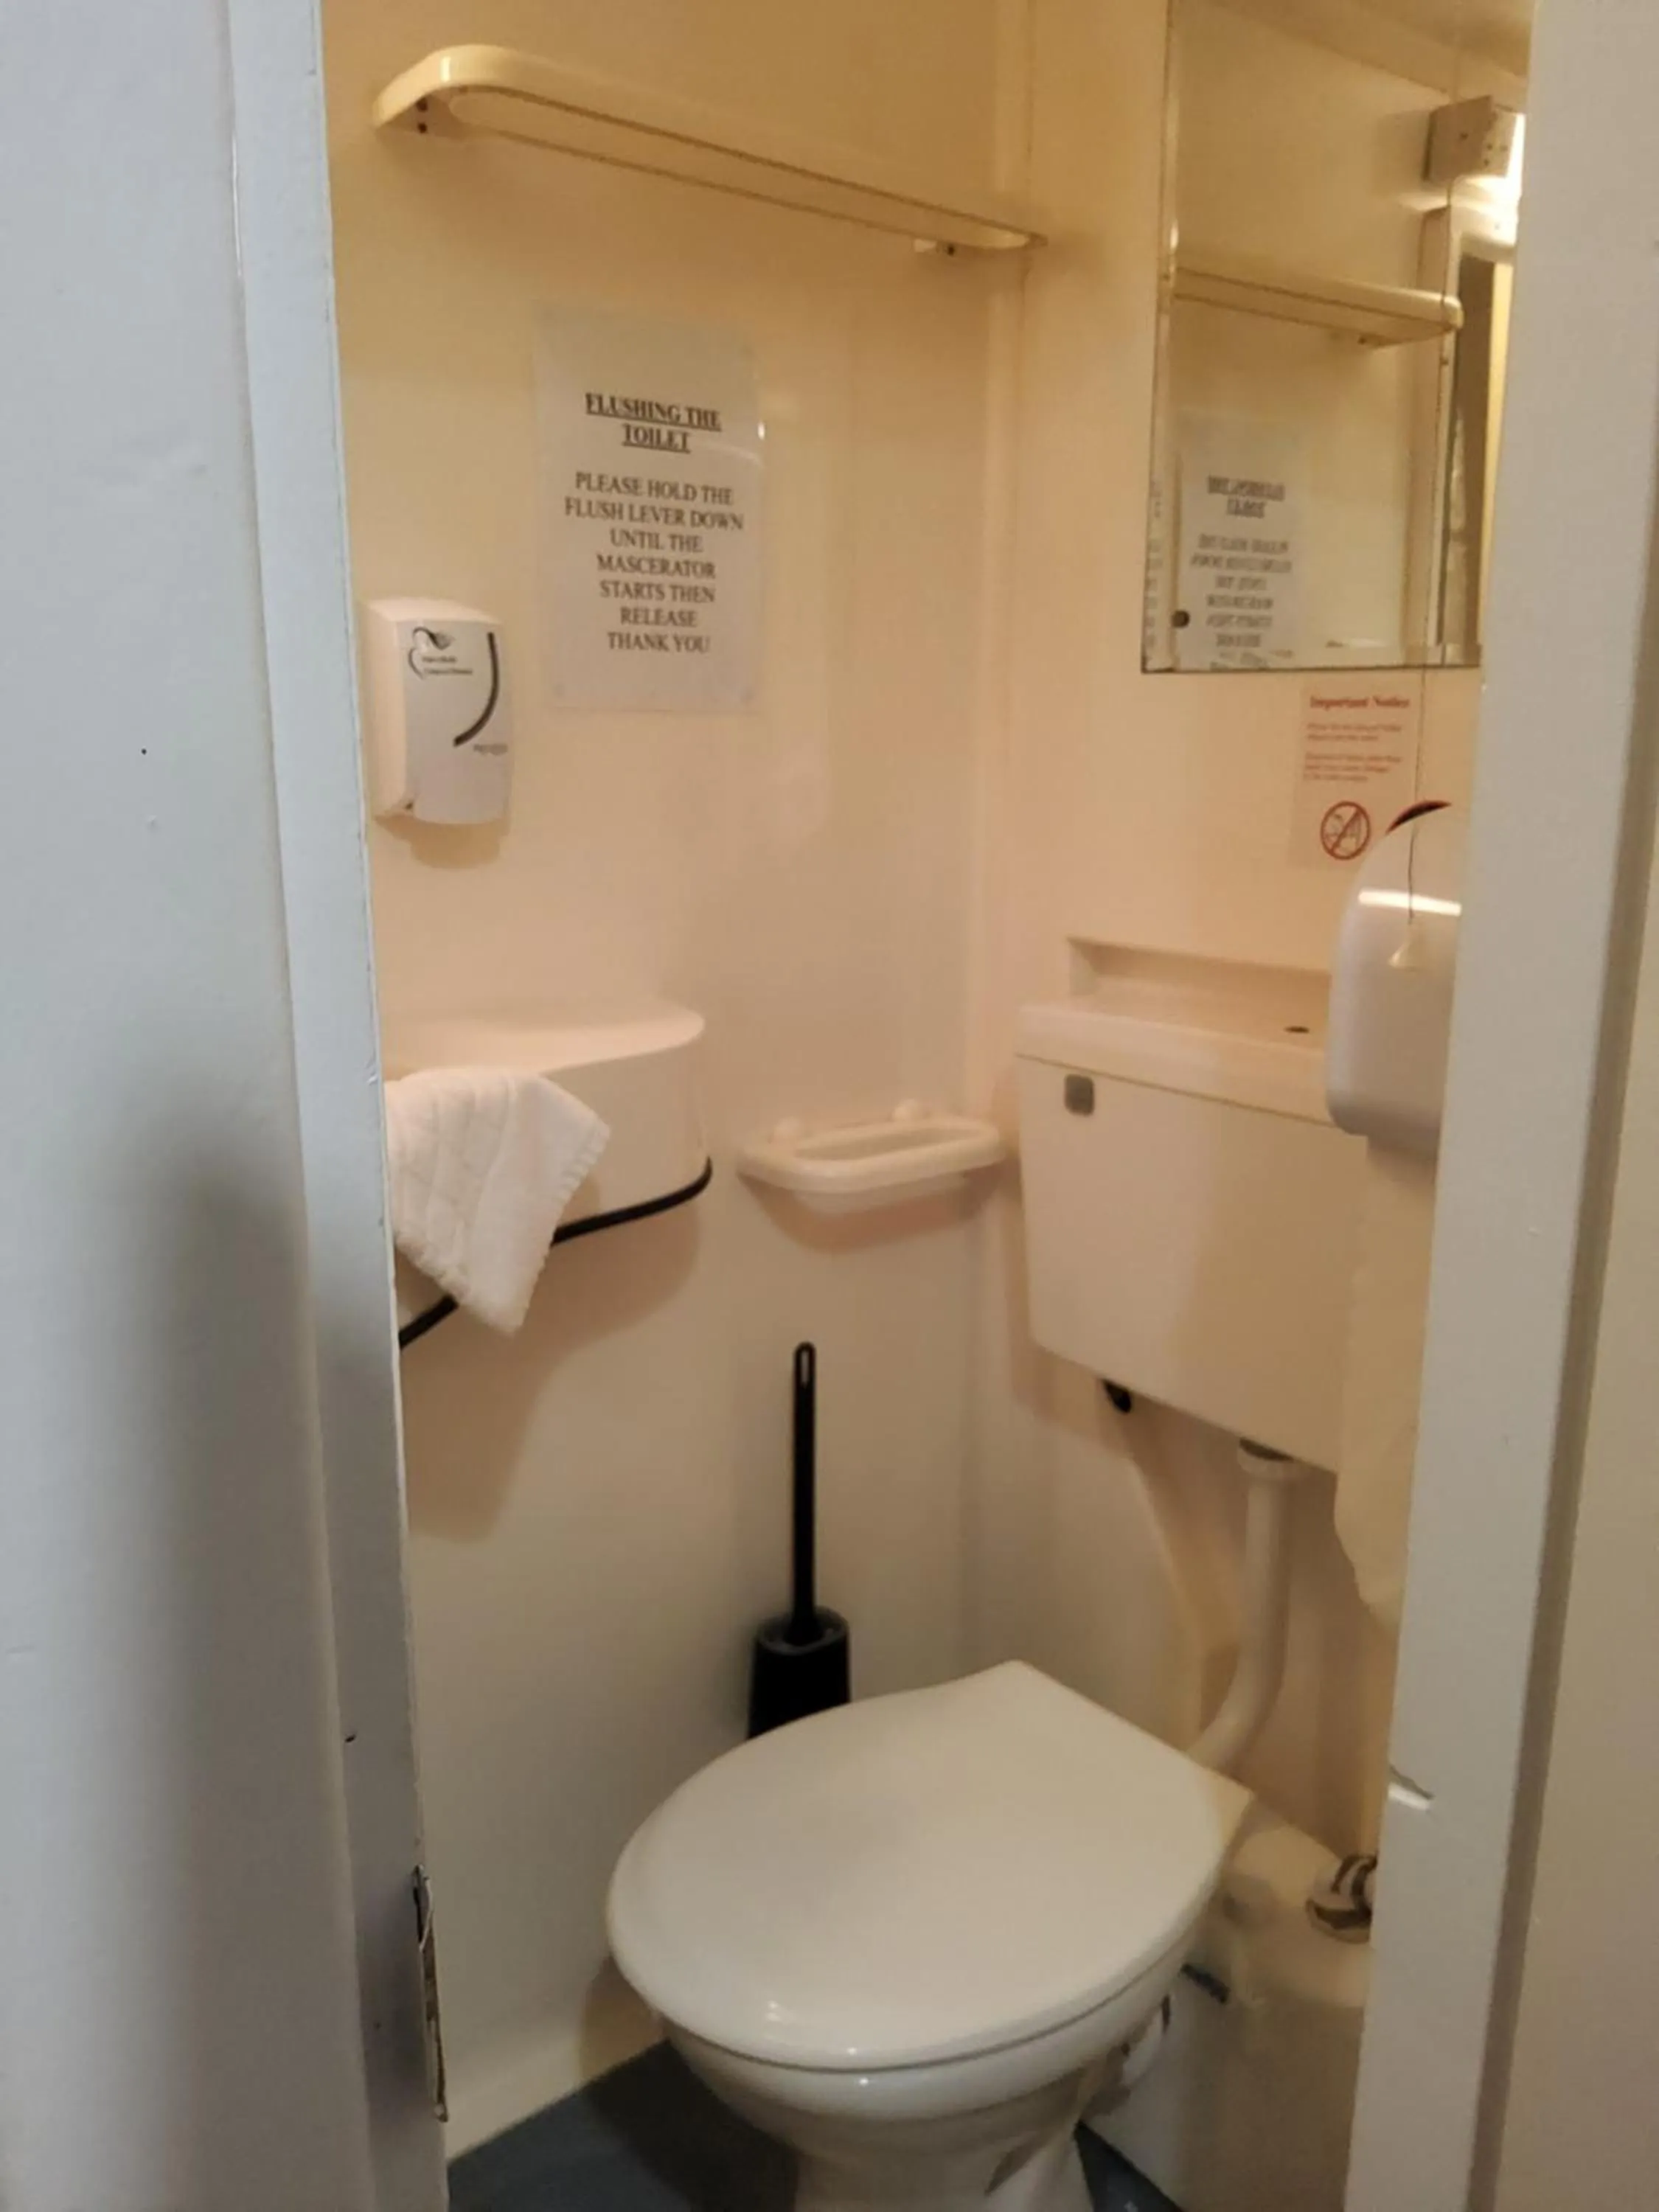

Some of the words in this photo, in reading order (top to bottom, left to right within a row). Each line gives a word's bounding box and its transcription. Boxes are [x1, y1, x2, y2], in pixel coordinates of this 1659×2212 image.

[585, 392, 681, 422] FLUSHING
[685, 406, 722, 430] THE
[623, 423, 691, 452] TOILET
[575, 471, 641, 496] PLEASE
[647, 479, 698, 502] HOLD
[700, 484, 733, 506] THE
[564, 496, 623, 520] FLUSH
[628, 503, 686, 526] LEVER
[689, 510, 743, 530] DOWN
[610, 528, 664, 550] UNTIL
[668, 534, 703, 553] THE
[597, 554, 716, 579] MASCERATOR
[599, 580, 666, 601] STARTS
[669, 584, 716, 603] THEN
[620, 606, 698, 627] RELEASE
[608, 631, 669, 653] THANK
[672, 635, 711, 653] YOU
